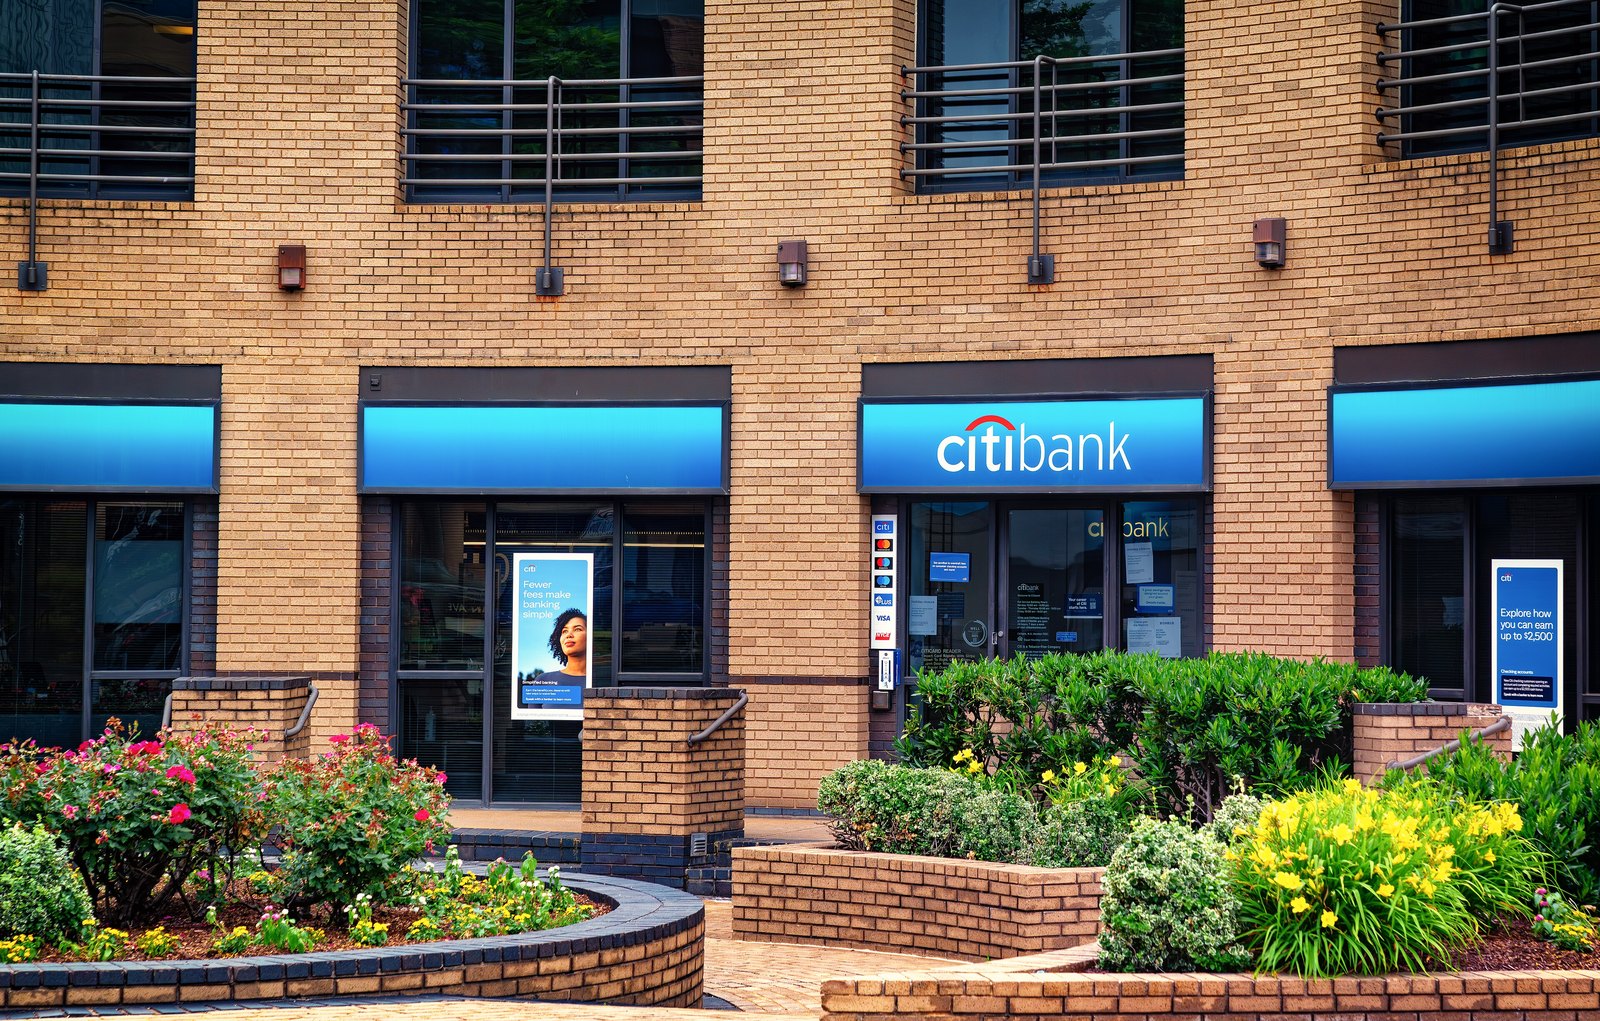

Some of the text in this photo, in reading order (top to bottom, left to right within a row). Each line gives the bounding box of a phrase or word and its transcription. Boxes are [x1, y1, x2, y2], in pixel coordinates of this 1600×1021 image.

[937, 415, 1132, 473] citibank
[876, 522, 890, 531] citi
[523, 564, 536, 573] citi
[1500, 572, 1512, 582] citi
[523, 580, 552, 589] Fewer
[1017, 583, 1040, 591] citibank
[523, 590, 571, 599] fees make
[523, 600, 560, 611] banking
[523, 610, 553, 619] simple
[1500, 608, 1552, 619] Explore how
[1500, 621, 1554, 630] you can earn
[1500, 632, 1512, 641] up
[1513, 632, 1522, 640] to
